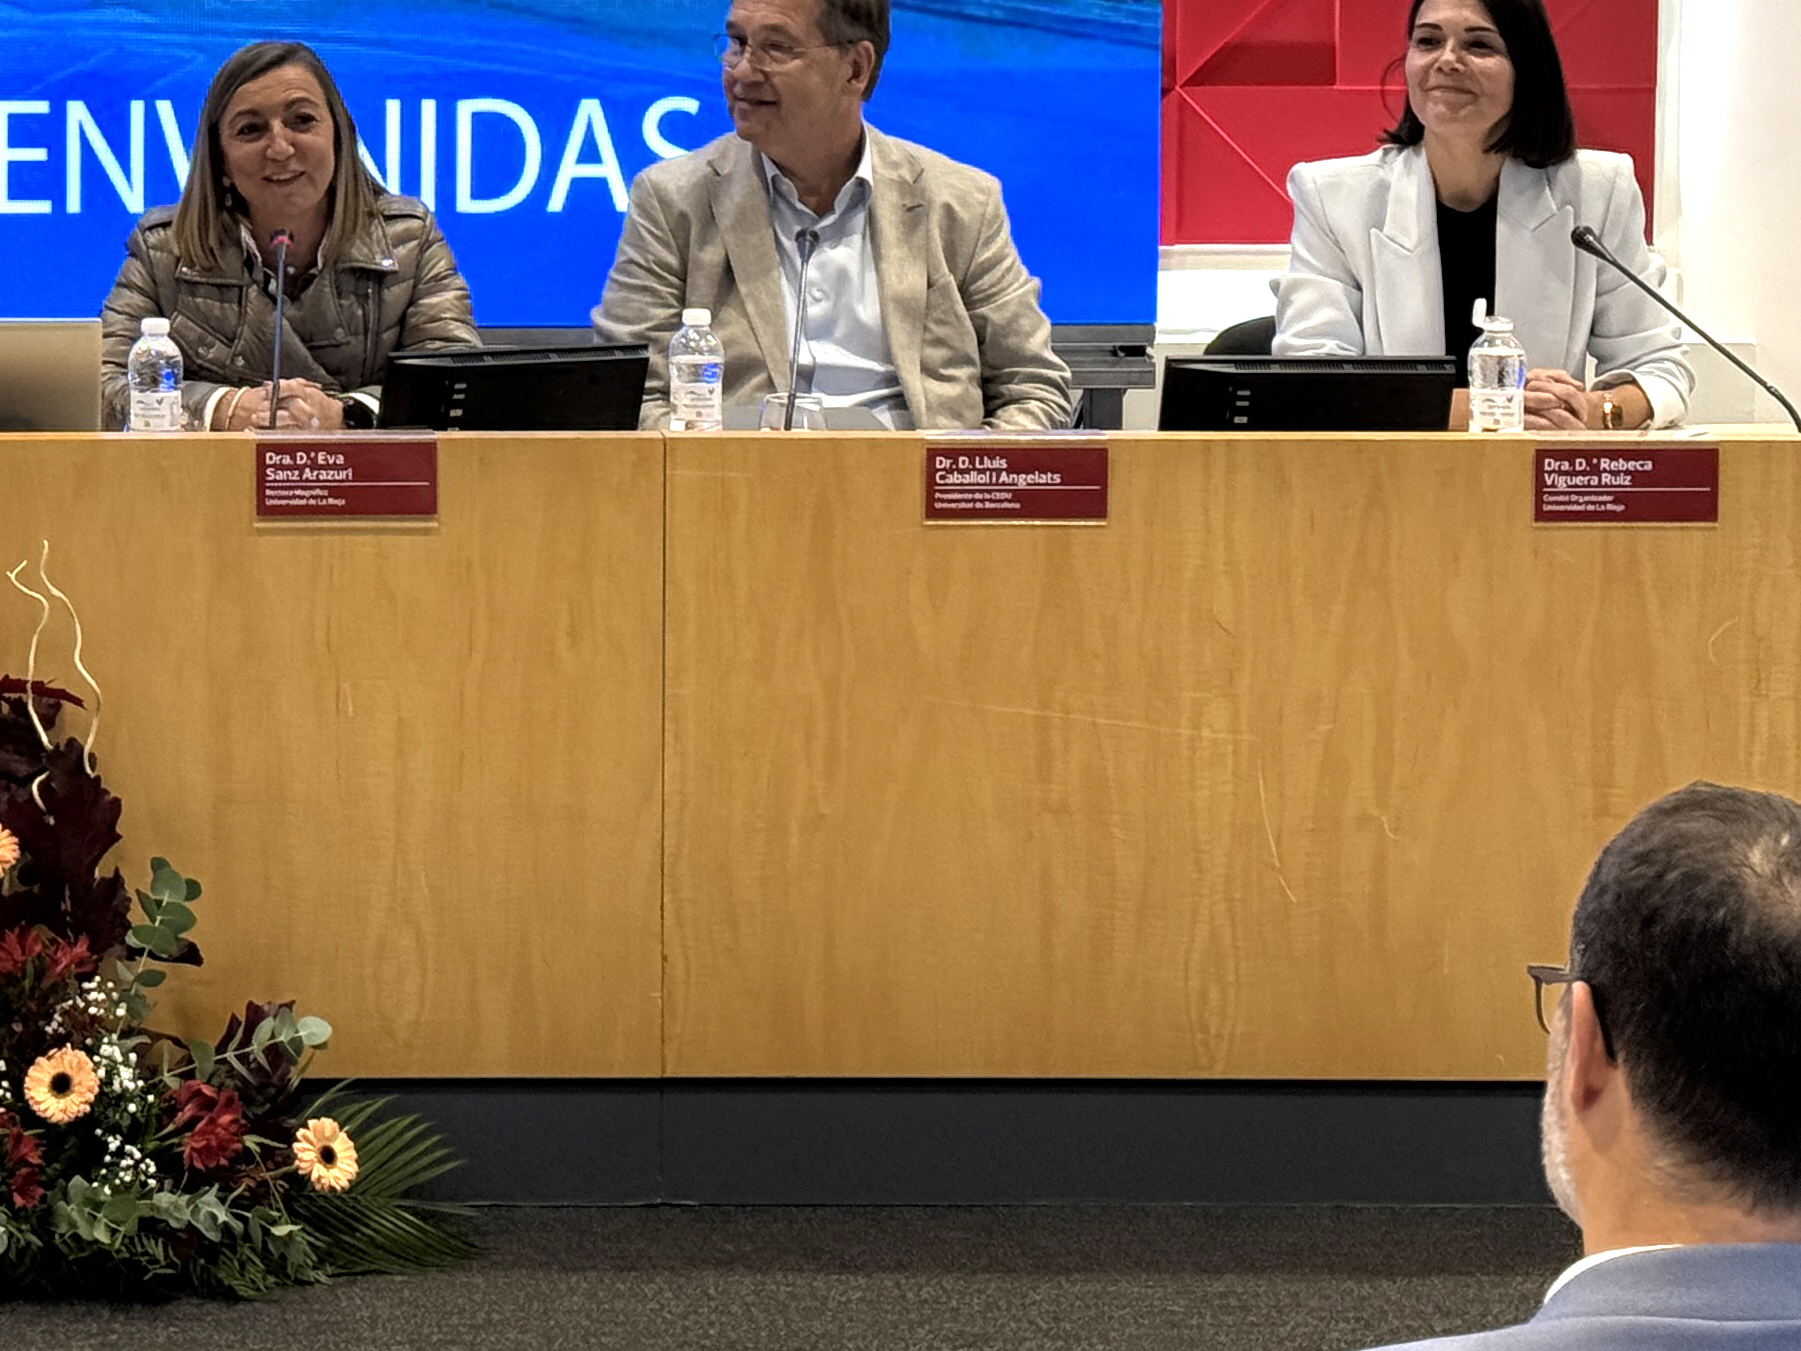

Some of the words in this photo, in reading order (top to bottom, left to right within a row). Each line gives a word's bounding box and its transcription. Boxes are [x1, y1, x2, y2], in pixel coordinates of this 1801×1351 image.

[265, 452, 293, 465] Dra.
[317, 451, 345, 465] Eva
[935, 456, 956, 469] Dr.
[958, 456, 972, 469] D.
[1543, 458, 1573, 471] Dra.
[1600, 458, 1653, 471] Rebeca
[265, 468, 301, 481] Sanz
[302, 467, 353, 480] Arazuri
[935, 471, 990, 484] Caballol
[998, 471, 1062, 486] Angelats
[1543, 473, 1599, 488] Viguera
[1601, 473, 1633, 486] Ruiz
